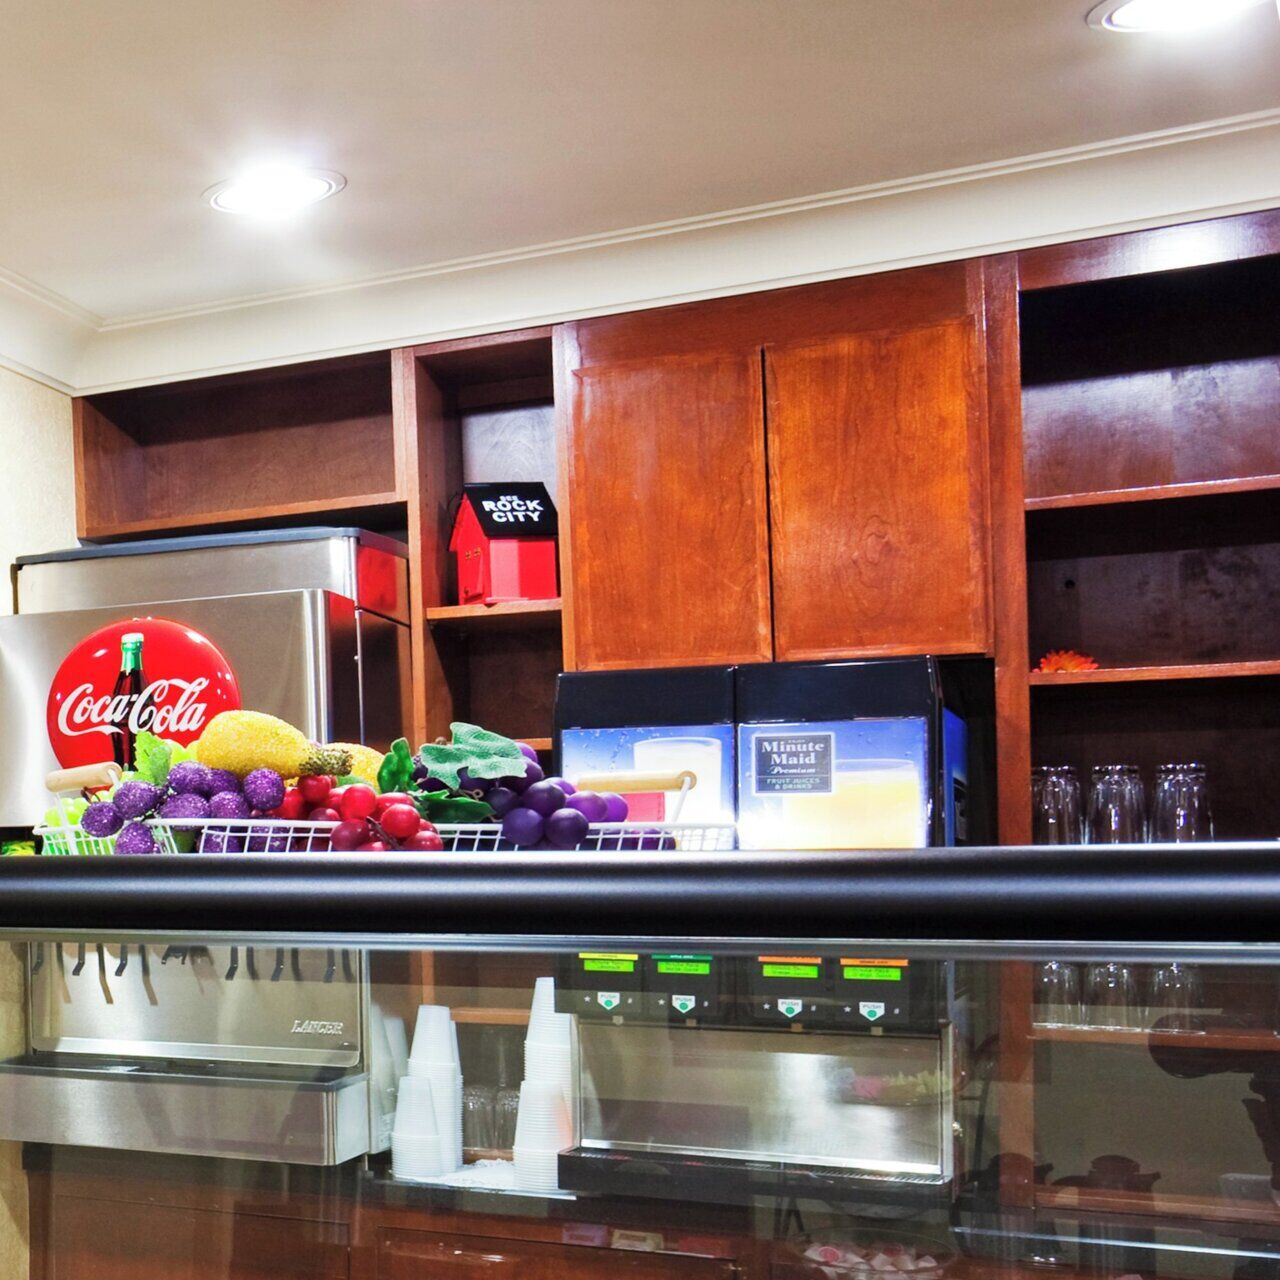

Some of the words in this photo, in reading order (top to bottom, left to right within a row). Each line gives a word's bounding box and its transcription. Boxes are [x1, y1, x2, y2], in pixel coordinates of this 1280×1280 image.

[482, 500, 544, 511] ROCK
[492, 511, 540, 522] CITY
[57, 677, 209, 736] Coca-Cola
[762, 741, 825, 752] Minute
[771, 752, 816, 765] Maid
